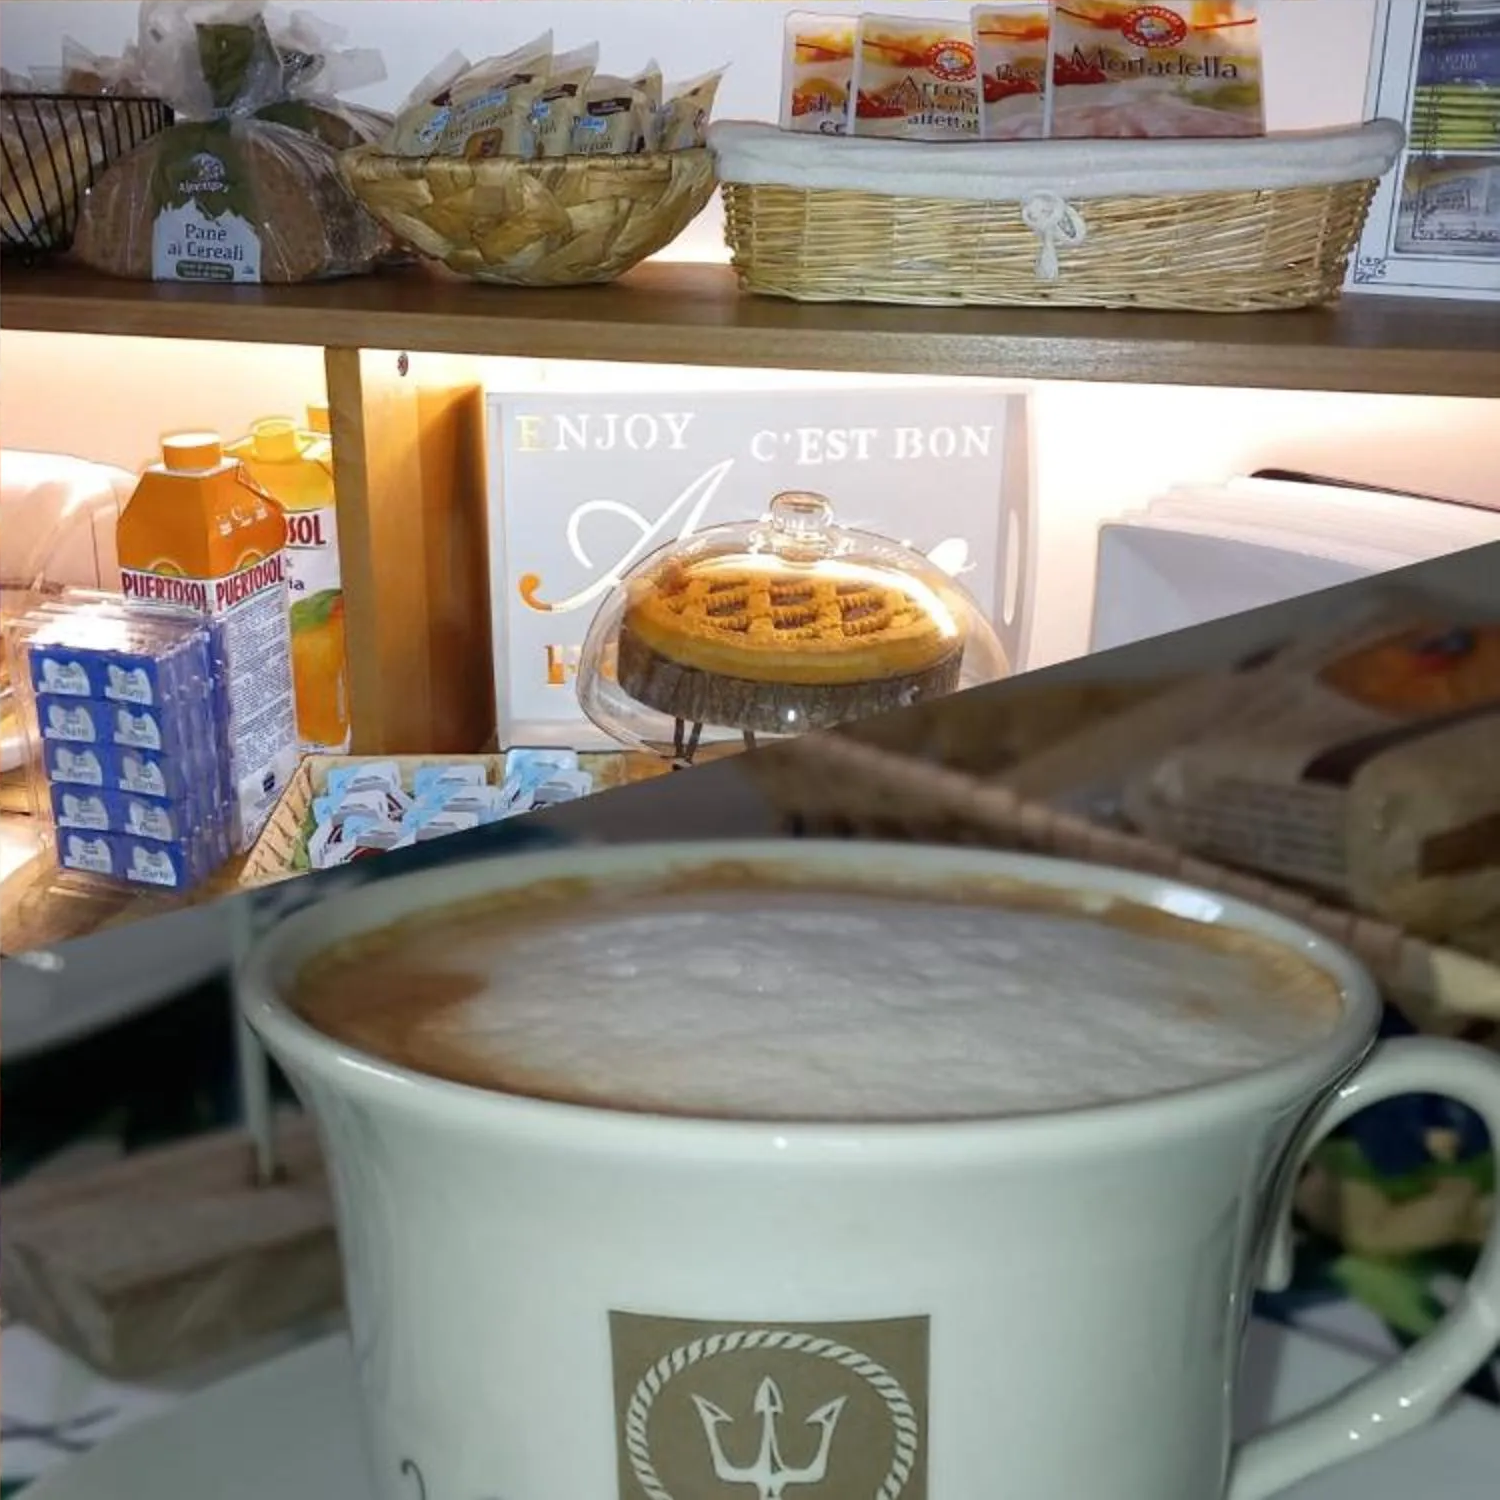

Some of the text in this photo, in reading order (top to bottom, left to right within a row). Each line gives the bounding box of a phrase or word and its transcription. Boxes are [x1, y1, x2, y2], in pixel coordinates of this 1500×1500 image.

[1070, 43, 1239, 80] Mortadella
[896, 75, 978, 102] Arros
[185, 223, 227, 241] Pane
[187, 241, 244, 261] Cereali
[514, 413, 695, 452] ENJOY
[894, 425, 995, 460] BON
[286, 514, 326, 545] SOL
[215, 555, 286, 611] PUERTOSOL
